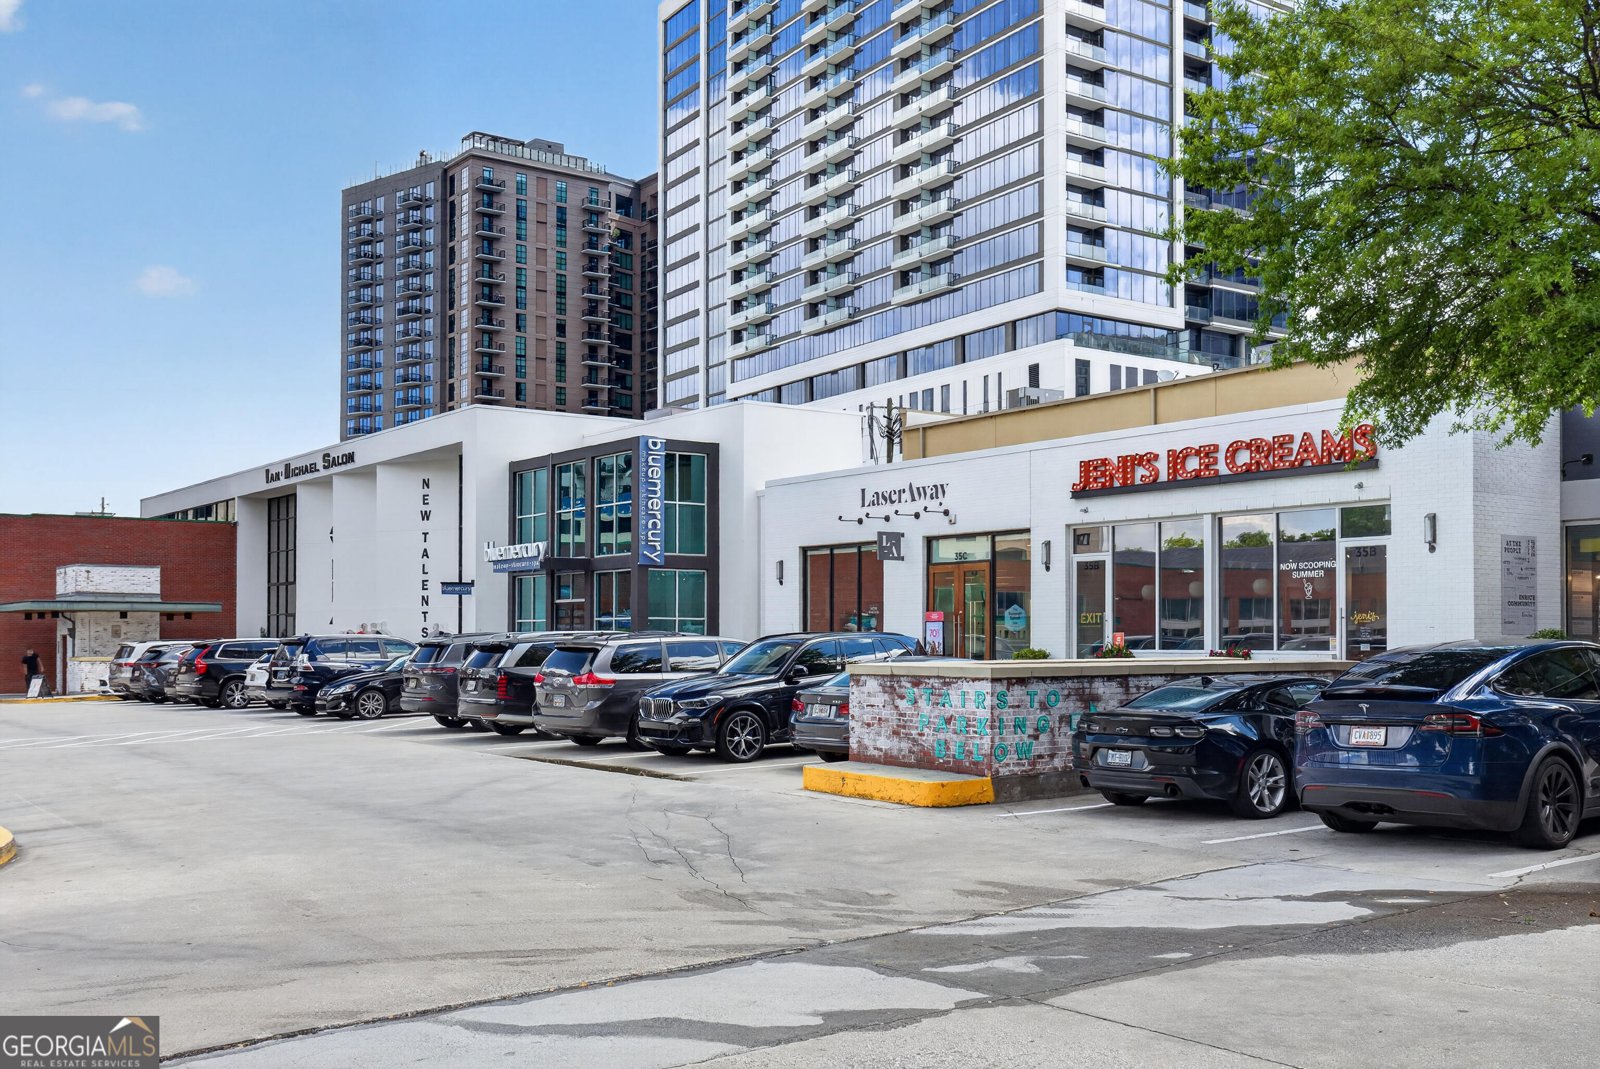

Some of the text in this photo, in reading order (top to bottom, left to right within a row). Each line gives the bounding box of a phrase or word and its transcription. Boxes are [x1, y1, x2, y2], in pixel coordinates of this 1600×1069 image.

[1072, 424, 1378, 491] JENI'S ICE CREAMS
[643, 438, 666, 562] bluemercury
[860, 481, 949, 507] LaserAway
[420, 478, 431, 638] NEW TALENTS
[483, 541, 548, 562] bluemercury
[954, 551, 968, 560] 35C
[1355, 546, 1377, 557] 35B
[1280, 560, 1337, 571] NOW SCOOPING
[1292, 570, 1324, 579] SUMMER
[1080, 612, 1102, 624] EXIT
[905, 687, 1061, 710] STAIRS TO
[918, 713, 1049, 736] PARKING
[935, 738, 1034, 762] BELOW
